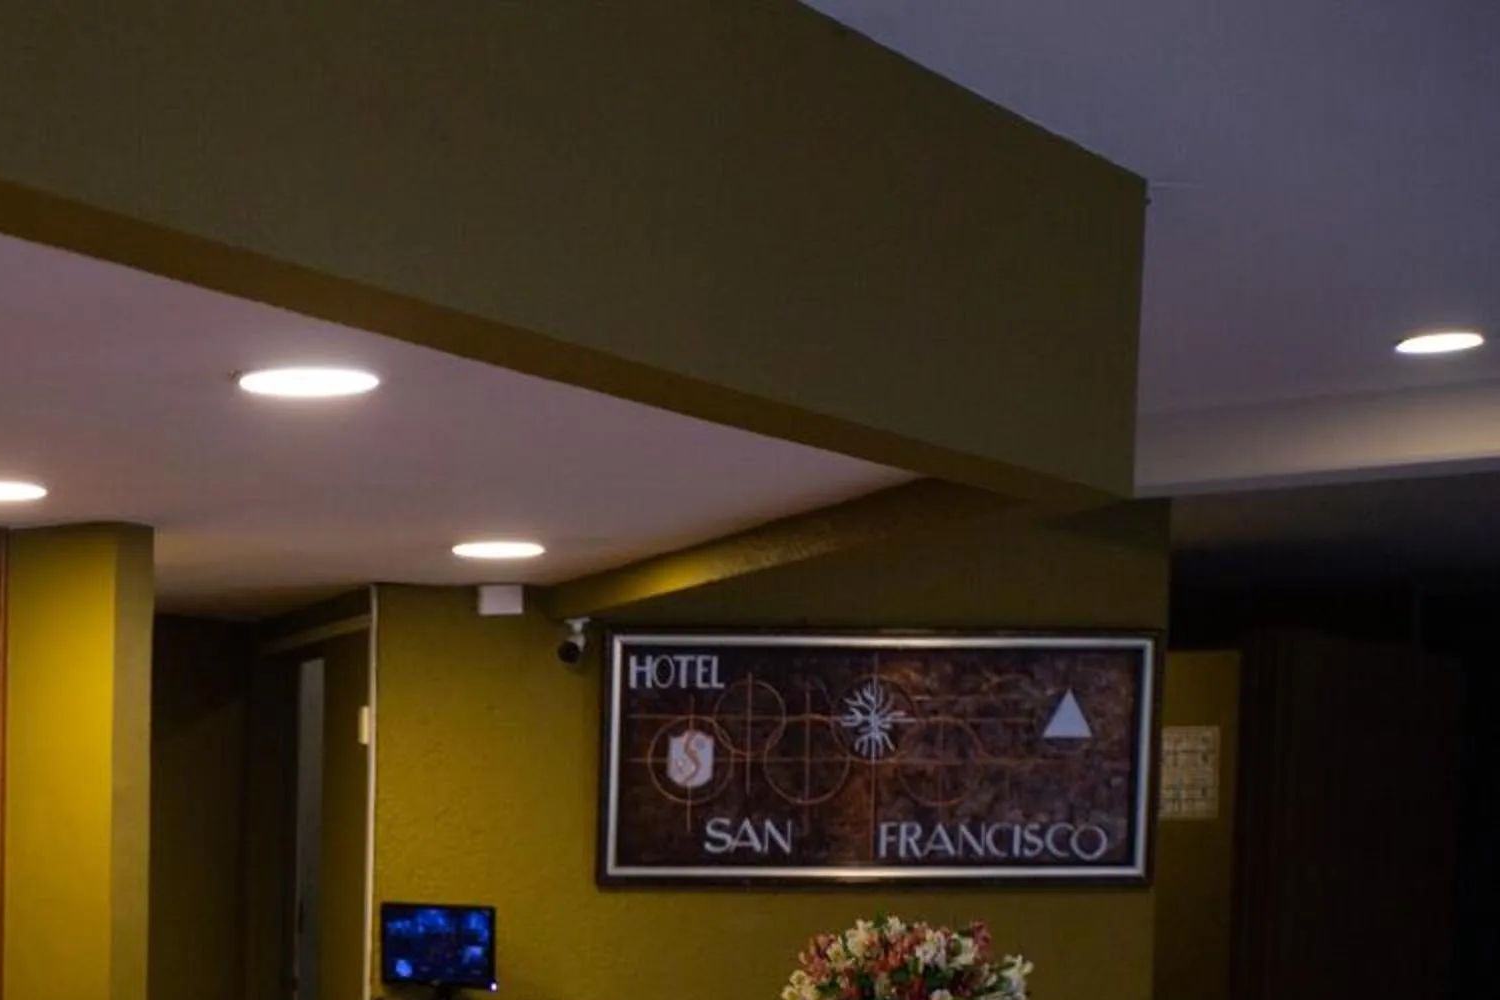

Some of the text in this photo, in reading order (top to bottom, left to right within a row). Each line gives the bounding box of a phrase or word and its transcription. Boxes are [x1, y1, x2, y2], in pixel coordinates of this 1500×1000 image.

[628, 654, 725, 690] HOTEL
[703, 817, 1108, 860] SAN FRANCISCO
